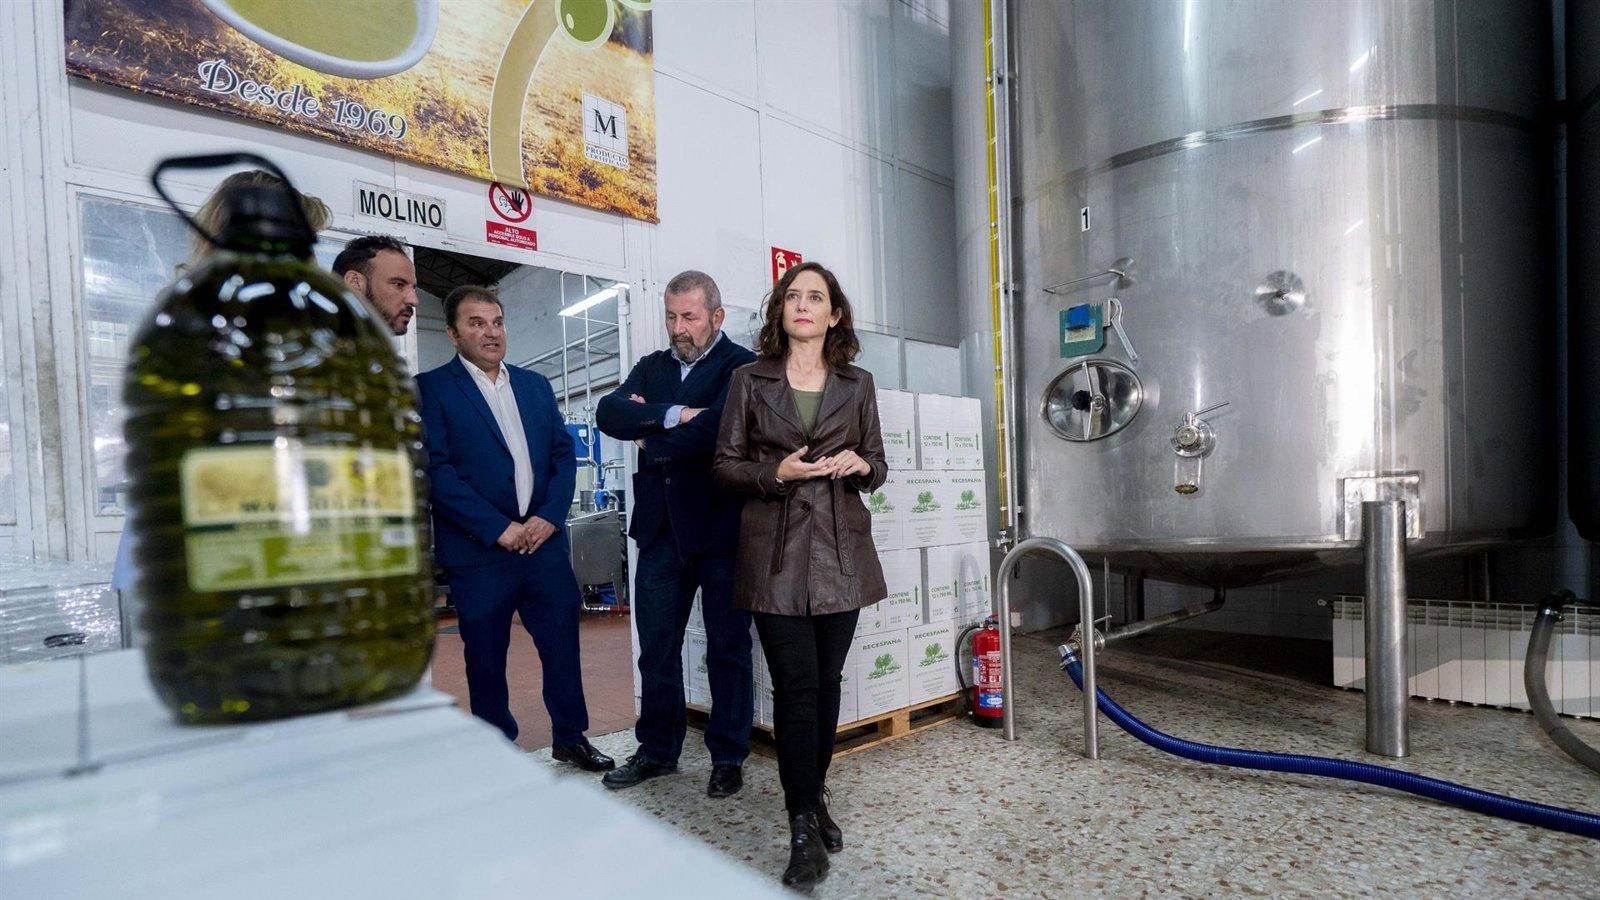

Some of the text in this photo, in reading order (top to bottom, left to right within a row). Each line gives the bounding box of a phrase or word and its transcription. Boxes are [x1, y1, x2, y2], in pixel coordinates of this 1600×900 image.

[198, 59, 408, 140] Desde 1969
[592, 108, 620, 140] M
[586, 146, 628, 163] PRODUCTO
[360, 189, 442, 227] MOLINO
[1083, 208, 1088, 229] 1
